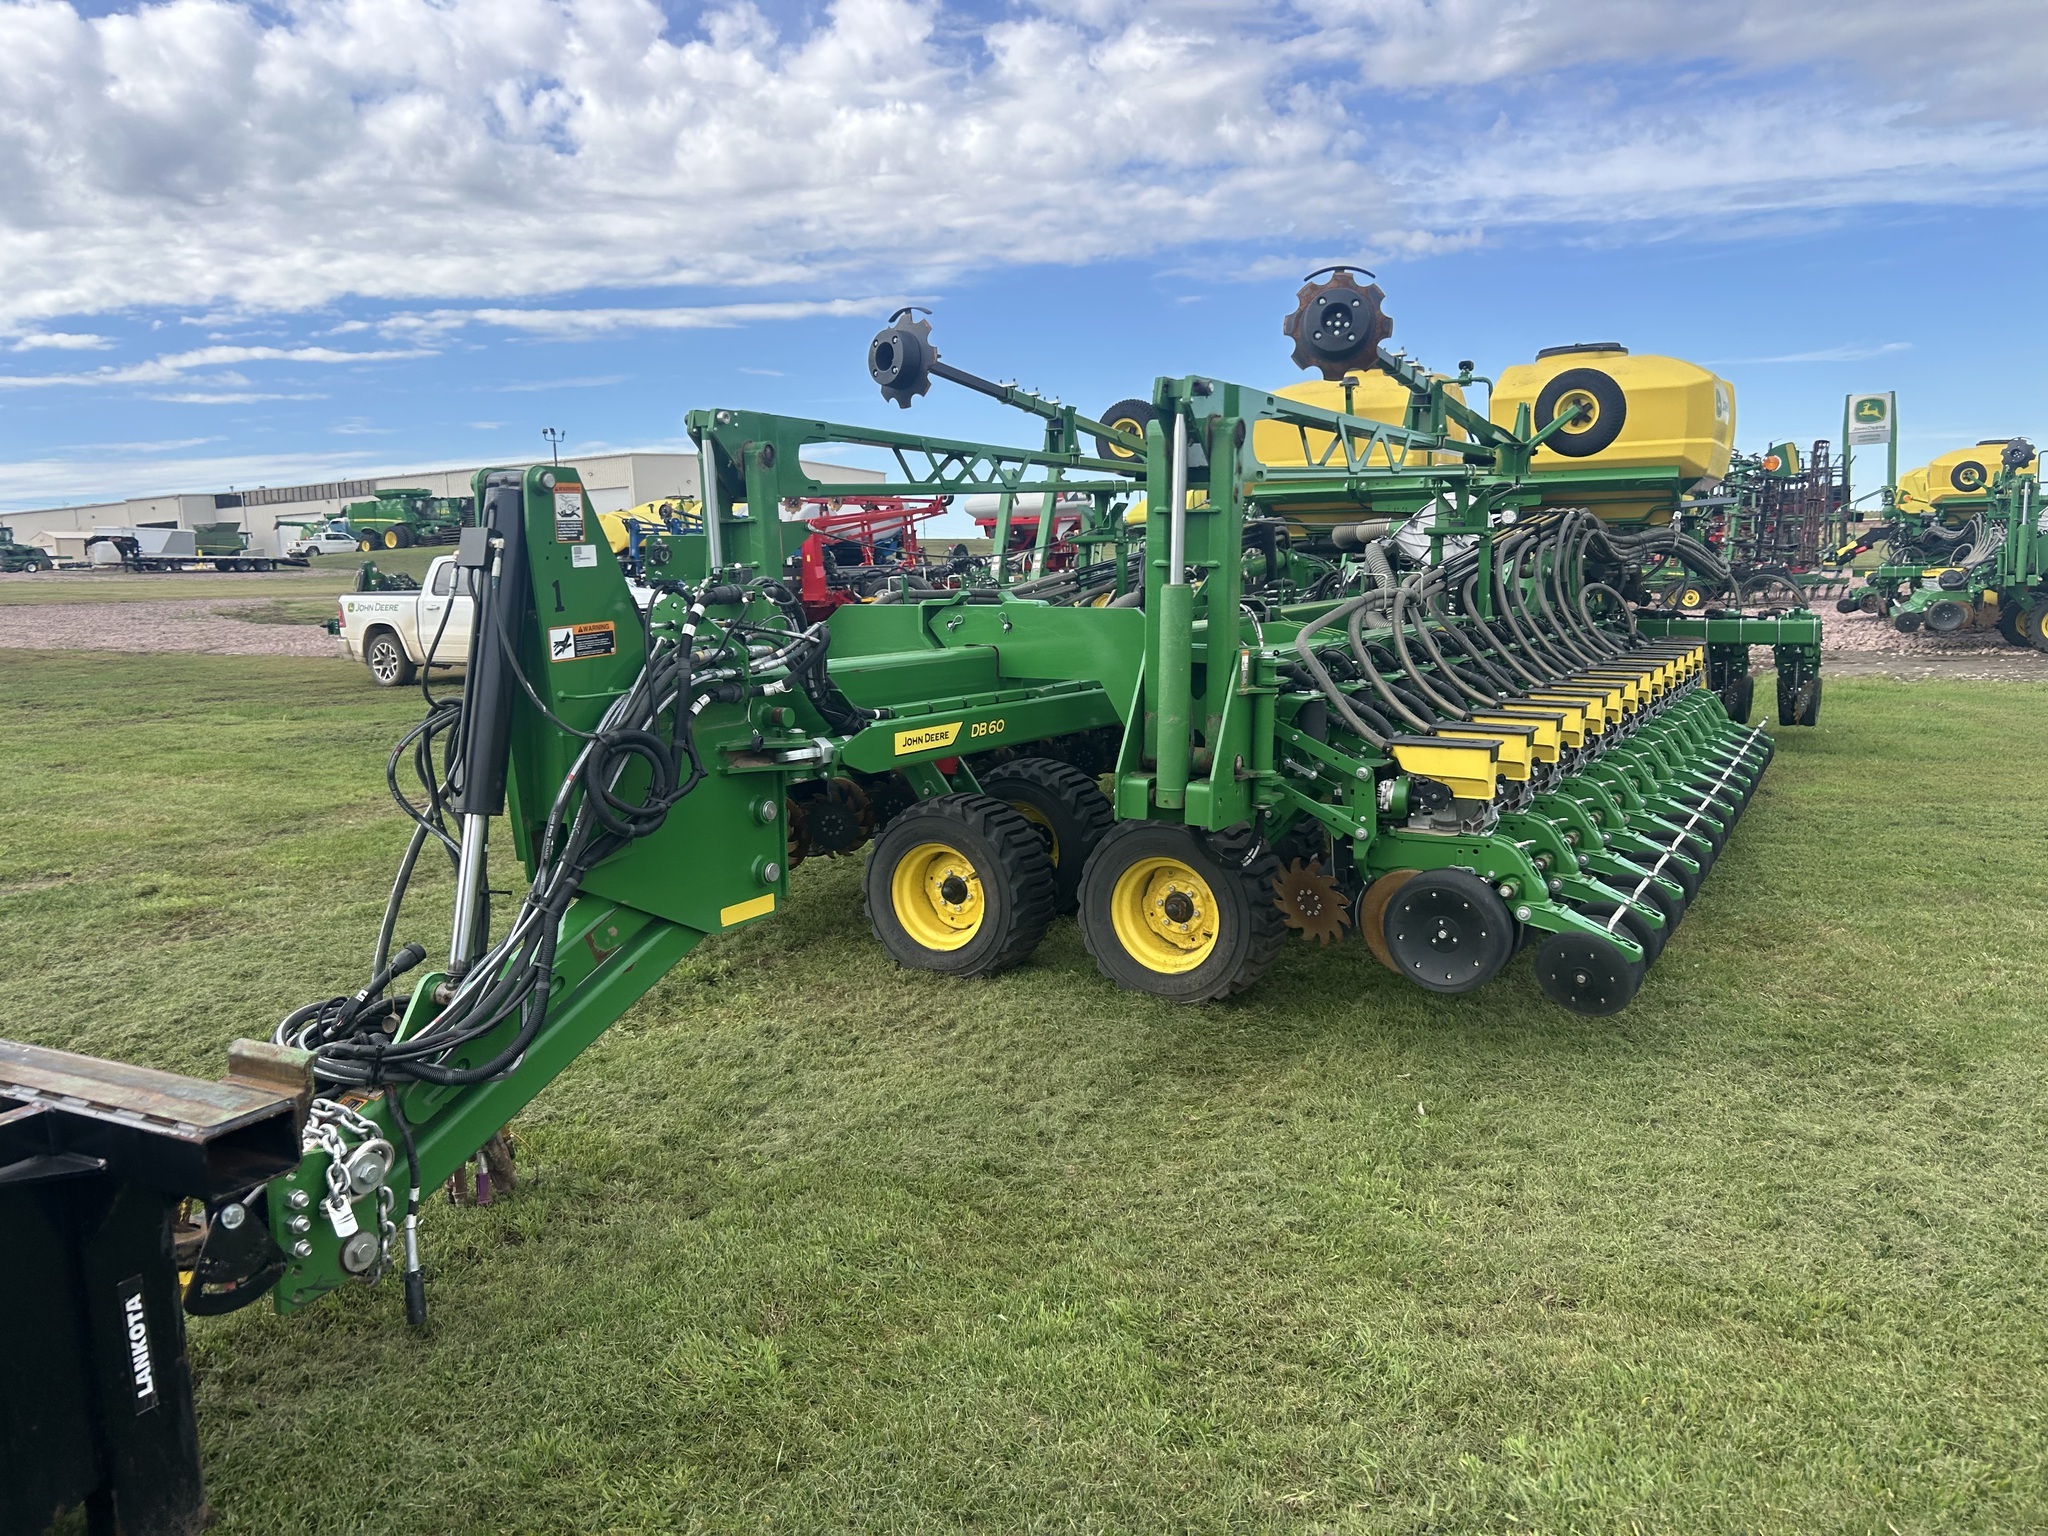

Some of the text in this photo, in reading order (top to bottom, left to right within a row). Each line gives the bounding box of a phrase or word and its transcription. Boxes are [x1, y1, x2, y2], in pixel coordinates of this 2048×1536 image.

[355, 602, 399, 611] JOHN DEERE
[552, 580, 565, 612] 1
[583, 623, 610, 632] WARNING
[902, 719, 1005, 747] JOHN DEERE DB 60
[125, 1292, 154, 1399] LANKOTA
